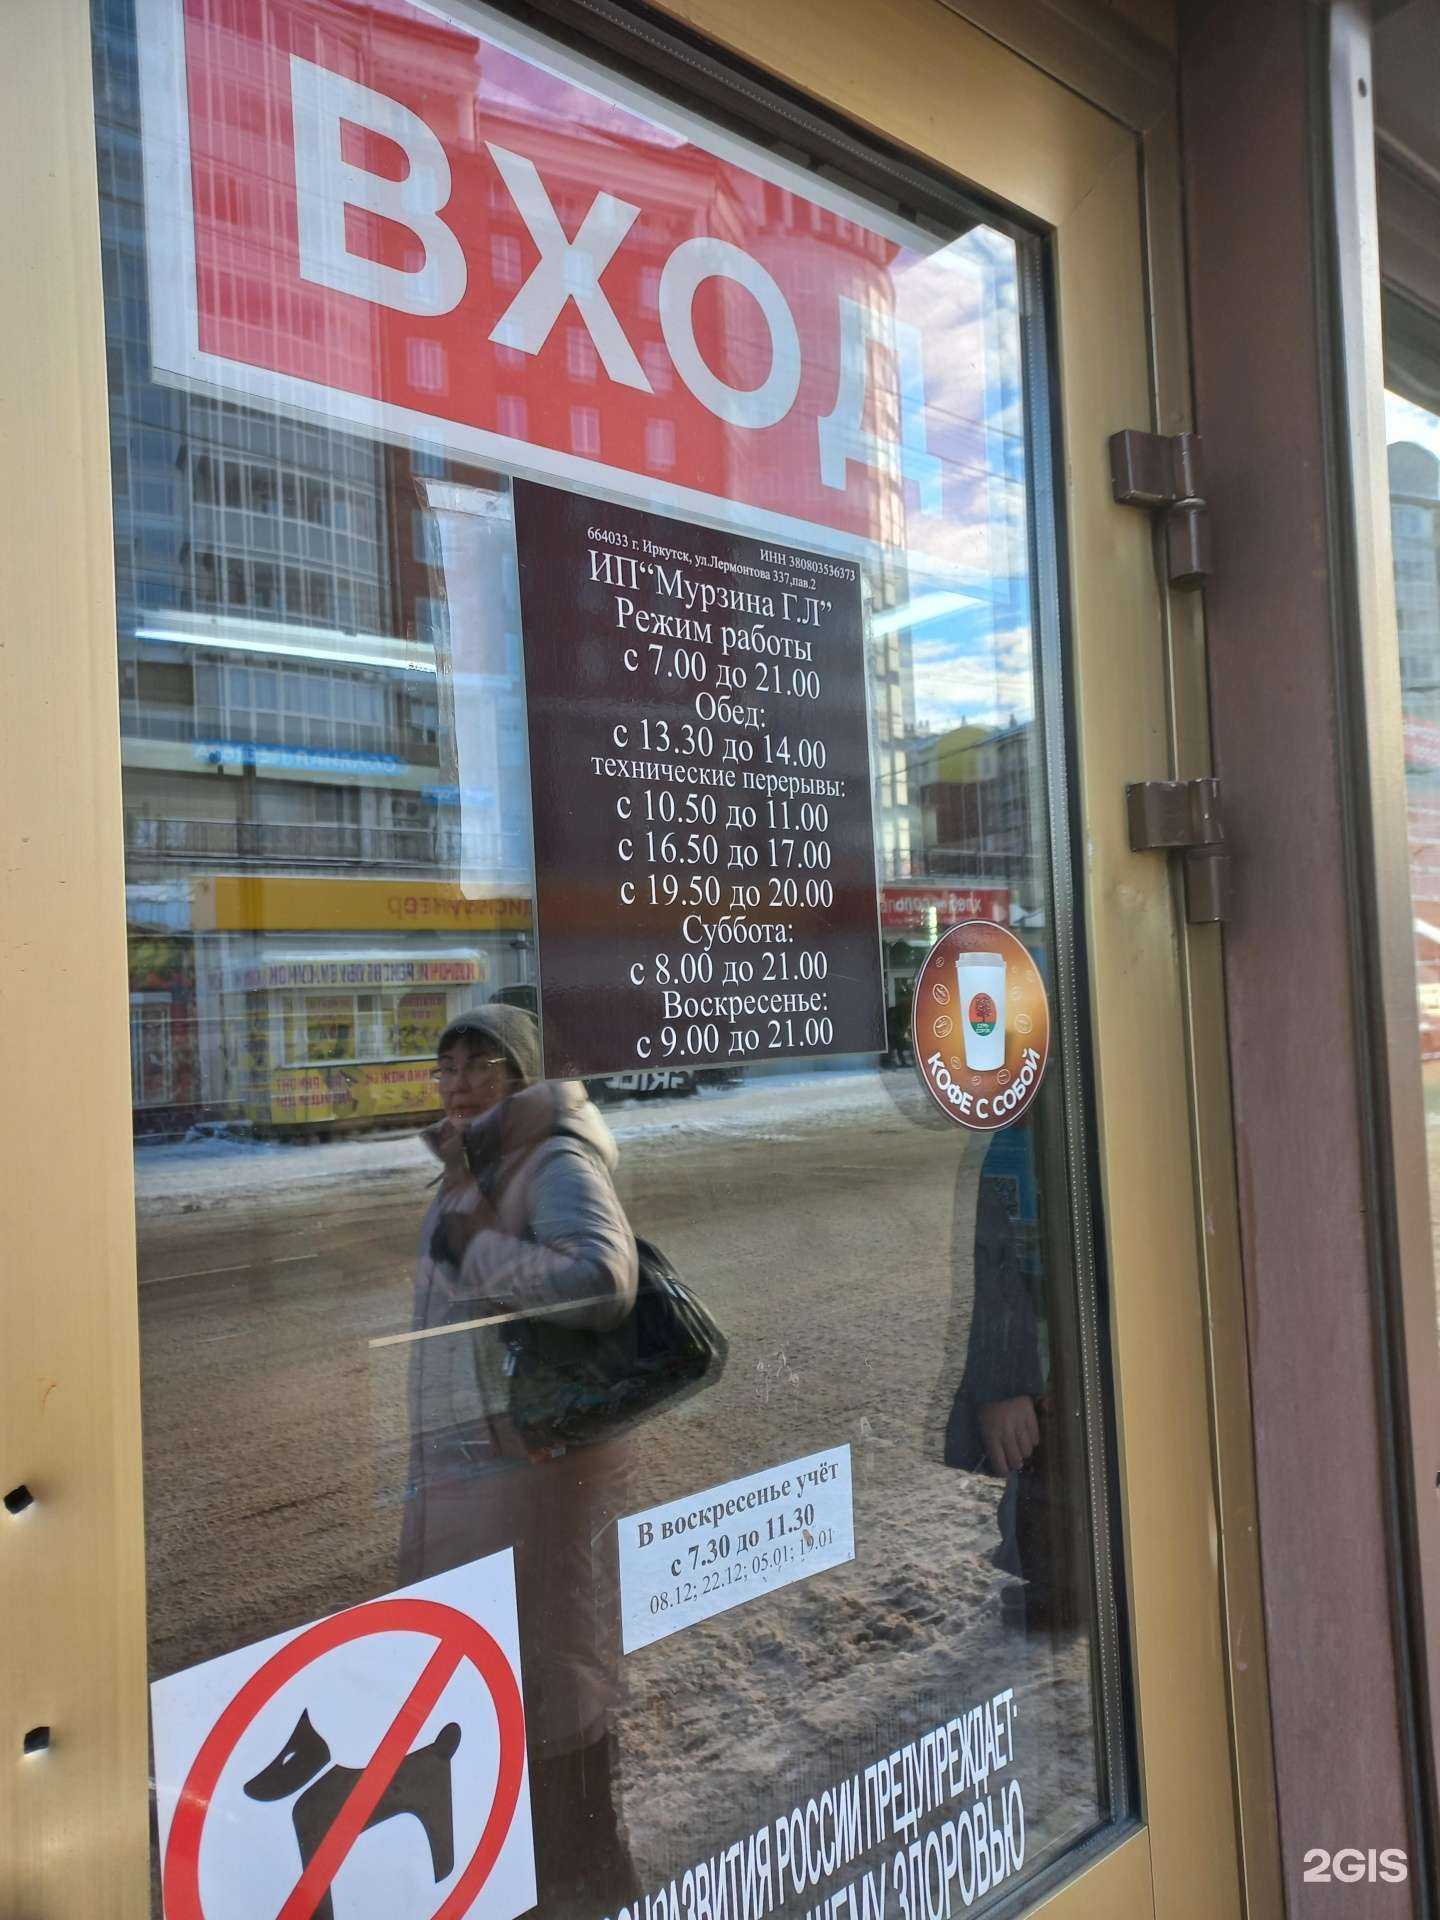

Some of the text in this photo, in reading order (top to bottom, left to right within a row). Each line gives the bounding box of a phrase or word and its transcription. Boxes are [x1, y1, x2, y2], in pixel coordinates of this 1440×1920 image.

[287, 53, 944, 518] ВХОД
[587, 526, 629, 548] 664033
[632, 540, 640, 551] г.
[643, 539, 693, 566] Иркутск,
[760, 549, 856, 581] ИНН 380803536373
[615, 595, 812, 661] Режим работы
[623, 643, 821, 700] с 7.00 до 21.00
[694, 691, 767, 728] Обед:
[612, 718, 827, 769] с 13.30 до 14.00
[590, 755, 846, 799] технические перерывы:
[616, 790, 829, 832] с 10.50 до 11.00
[618, 831, 832, 870] с 16.50 до 17.00
[620, 874, 834, 910] с 19.50 до 20.00
[682, 914, 794, 951] Суббота:
[630, 951, 828, 986] с 8.00 до 21.00
[662, 990, 829, 1023] Воскресенье:
[636, 1017, 834, 1059] с 9.00 до 21.00
[927, 1047, 1041, 1119] КОФЕ С СОБОЙ
[636, 1461, 839, 1549] В воскресенье учёт
[670, 1503, 815, 1576] с 7.30 до 11.30
[649, 1582, 698, 1615] 08.12;
[702, 1563, 748, 1594] 22.12;
[752, 1545, 794, 1574] 05.01;
[776, 1774, 864, 1905] РОССИИ
[892, 1779, 1026, 1920] ЗДОРОВЬЮ
